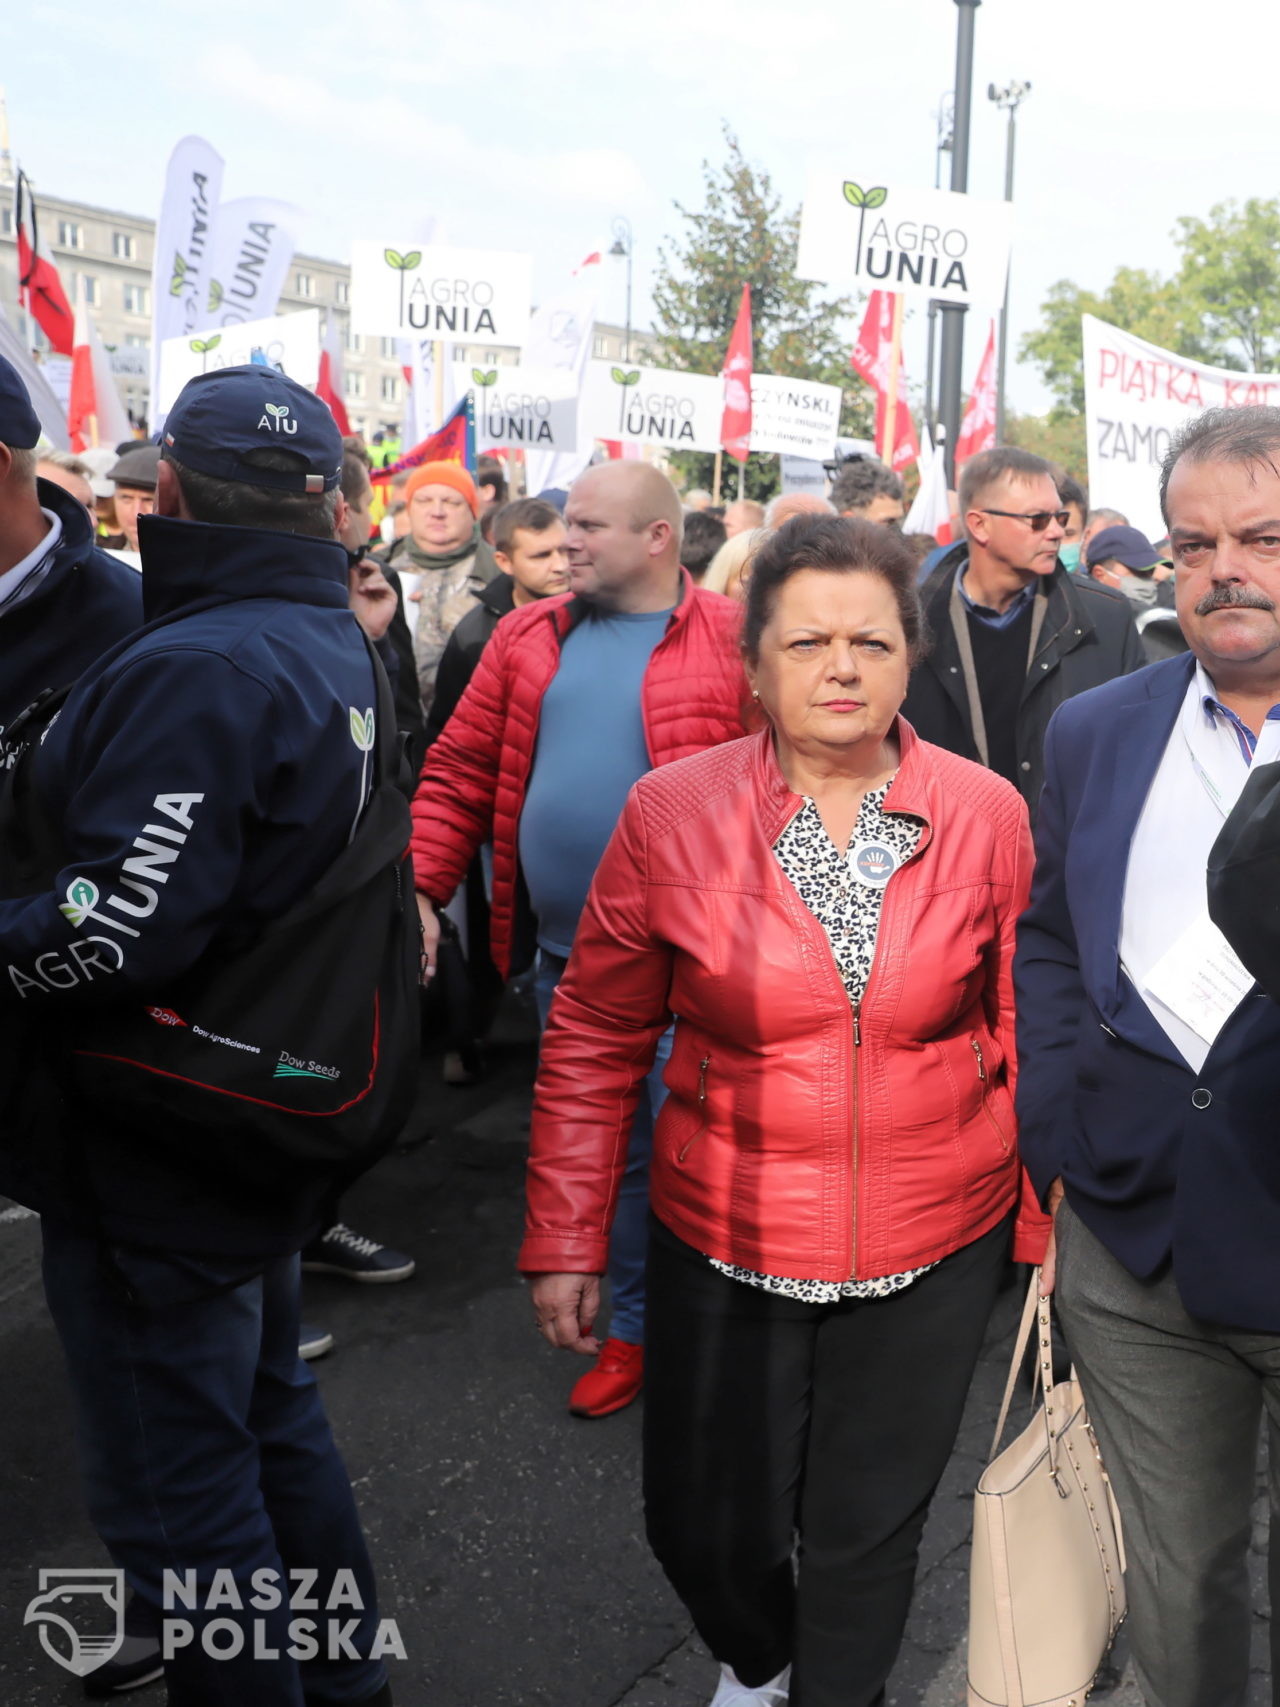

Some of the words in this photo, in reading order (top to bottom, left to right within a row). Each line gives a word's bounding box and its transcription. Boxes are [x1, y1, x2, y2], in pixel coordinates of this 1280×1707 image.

[868, 218, 968, 258] AGRO
[230, 222, 276, 299] UNIA
[866, 247, 968, 292] UNIA
[408, 277, 494, 306] AGRO
[408, 303, 496, 334] UNIA
[1098, 348, 1204, 407] PIĄTKA
[489, 393, 551, 419] AGRO
[628, 392, 696, 419] AGRO
[489, 415, 554, 444] UNIA
[627, 413, 696, 442] UNIA
[105, 792, 205, 919] UNIA
[278, 1050, 305, 1069] Dow
[307, 1061, 341, 1079] Seeds
